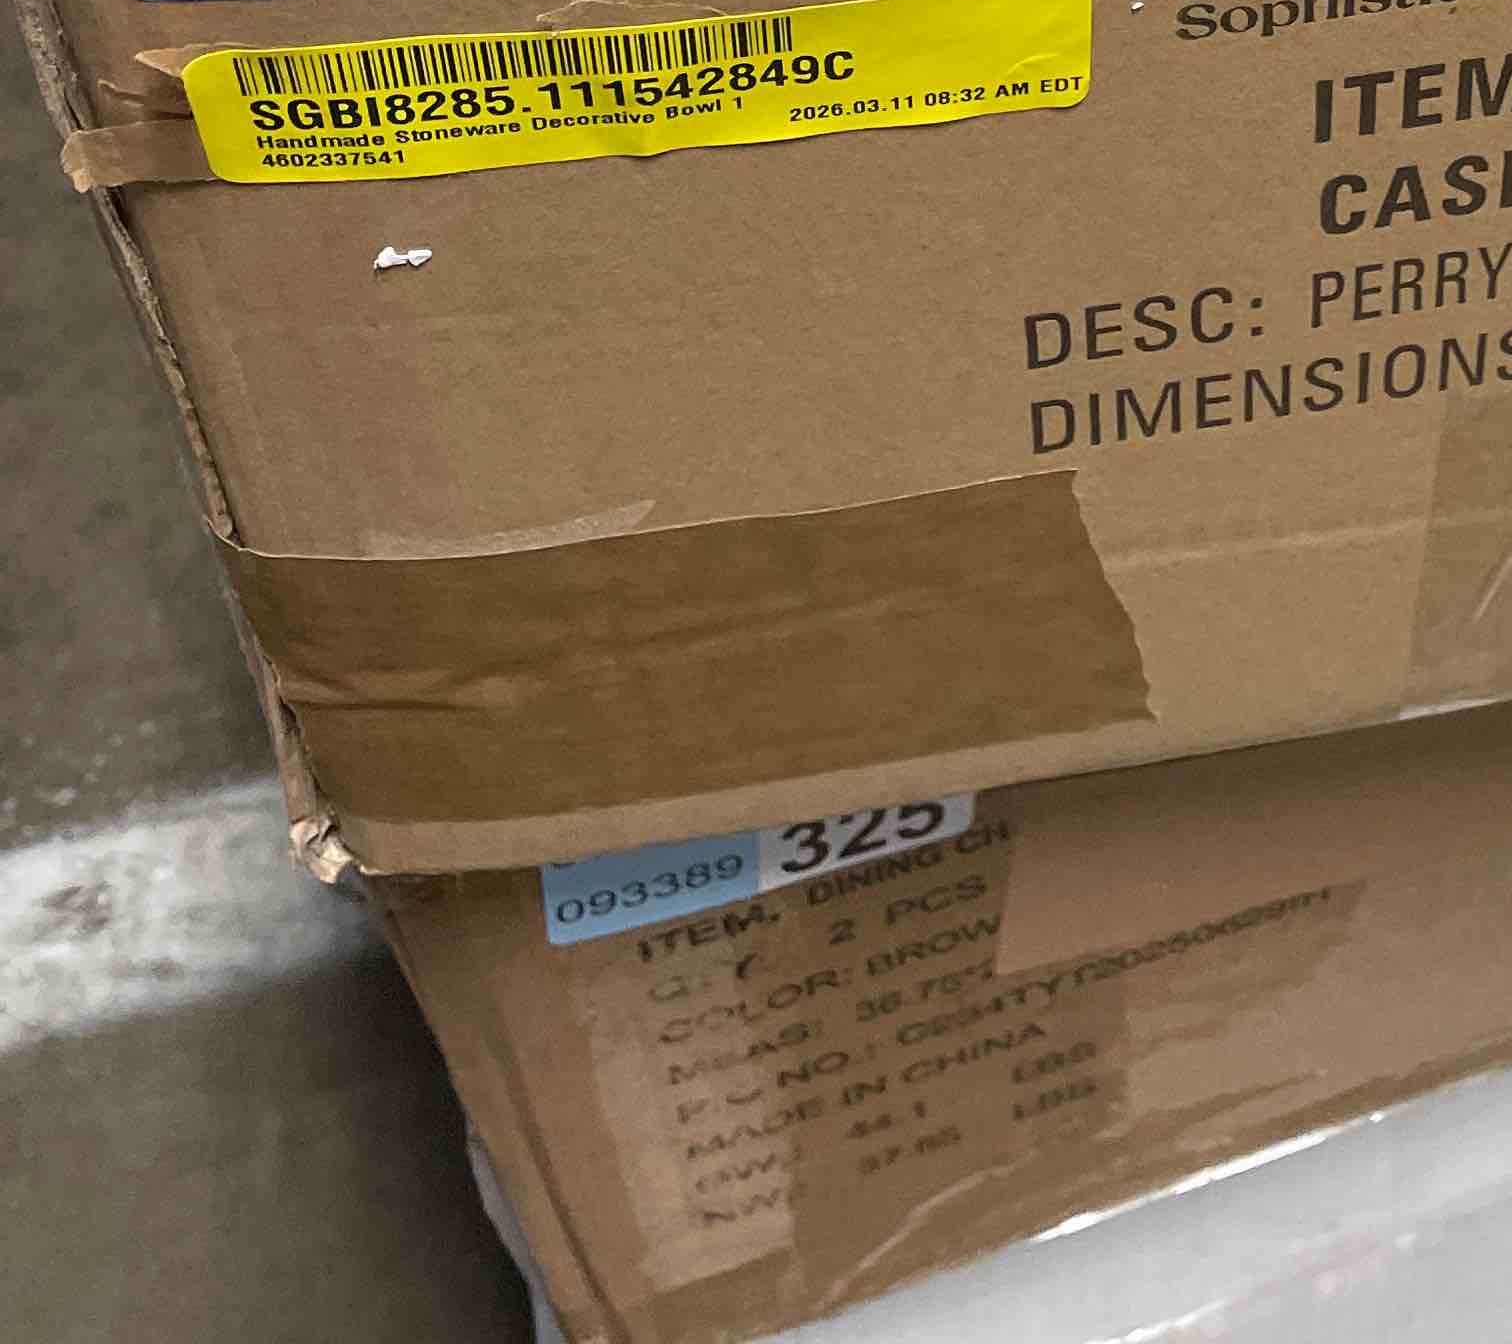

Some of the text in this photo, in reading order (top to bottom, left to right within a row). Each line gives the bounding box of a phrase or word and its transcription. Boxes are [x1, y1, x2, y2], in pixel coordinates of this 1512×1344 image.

[252, 50, 855, 131] SGBI8285.111542849C
[256, 96, 743, 151] Handmade Stoneware Decorative Bowl 1
[790, 75, 1084, 123] 2026.03.11 08:32 AM EDT
[262, 149, 405, 169] 4602337541
[1024, 284, 1266, 371] DESC:
[780, 801, 946, 874] 325
[557, 853, 744, 924] 093389
[807, 848, 944, 907] DINING
[826, 874, 987, 946] 2 PCS
